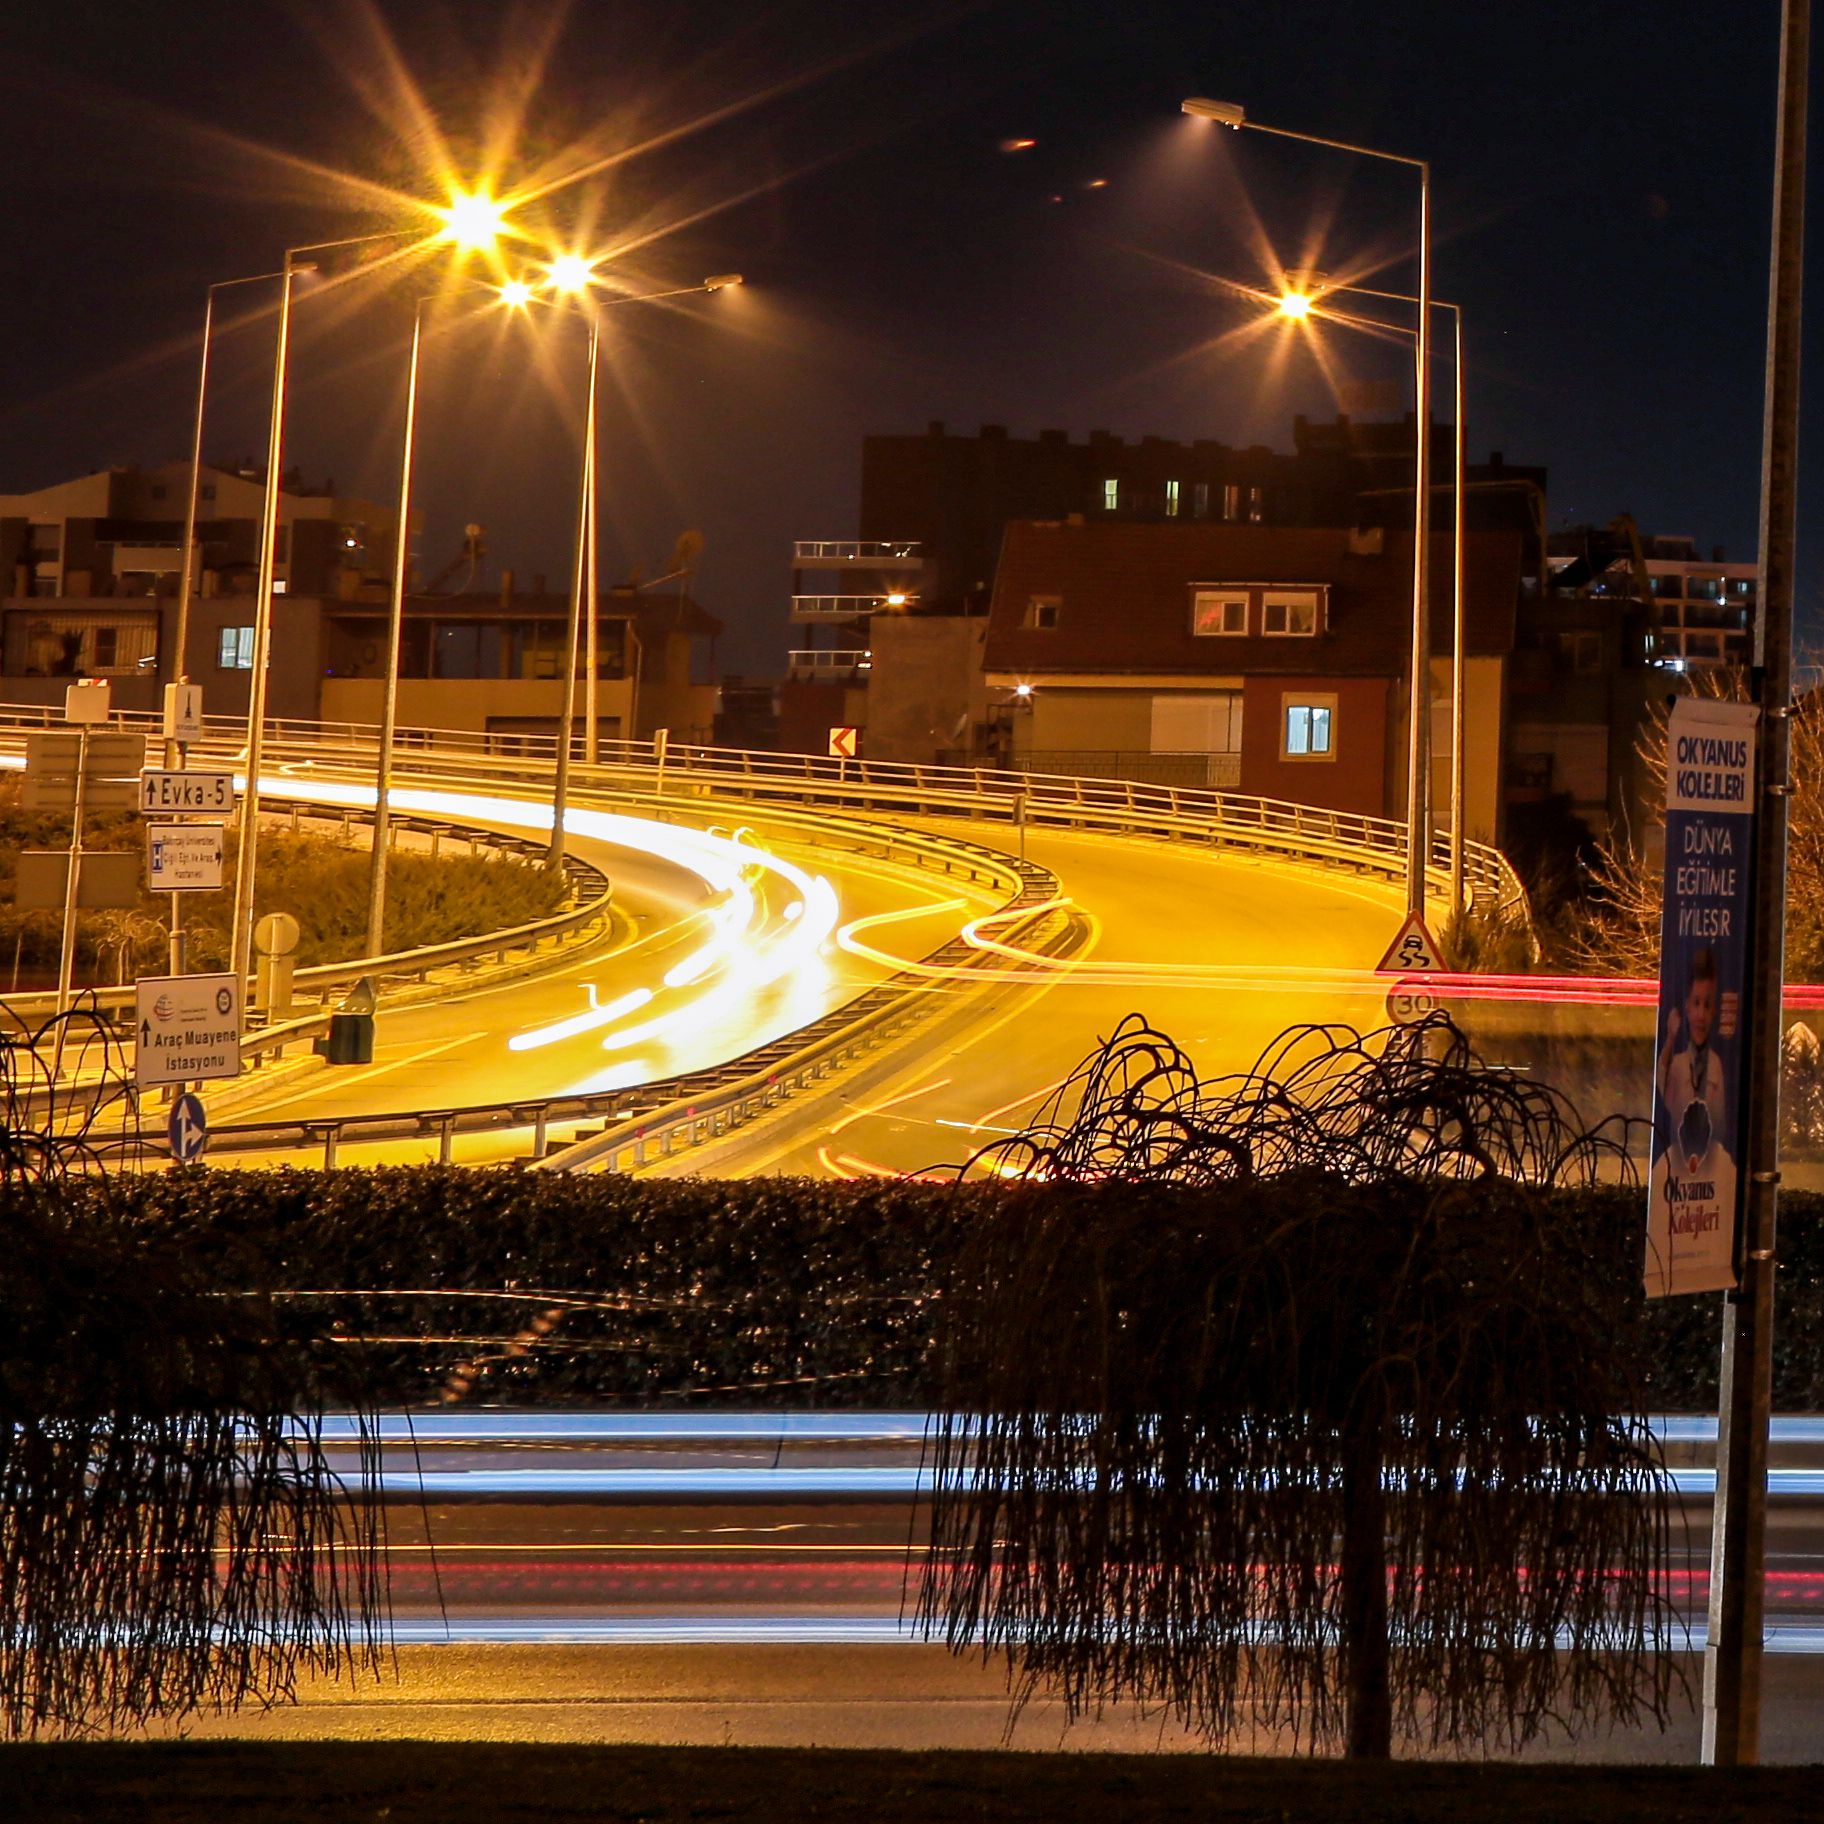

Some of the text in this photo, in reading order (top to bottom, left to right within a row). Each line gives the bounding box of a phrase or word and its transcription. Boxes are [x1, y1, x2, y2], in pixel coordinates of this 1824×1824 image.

[1677, 736, 1747, 768] OKYANUS
[161, 778, 225, 806] Evka-5
[1677, 770, 1744, 802] KOLEJLERİ
[1684, 819, 1733, 855] DÜNYA
[1676, 859, 1736, 896] EĞİTİMLE
[1397, 994, 1432, 1015] 30
[154, 1030, 236, 1050] Araç Muayene
[166, 1053, 225, 1072] İstasyonu
